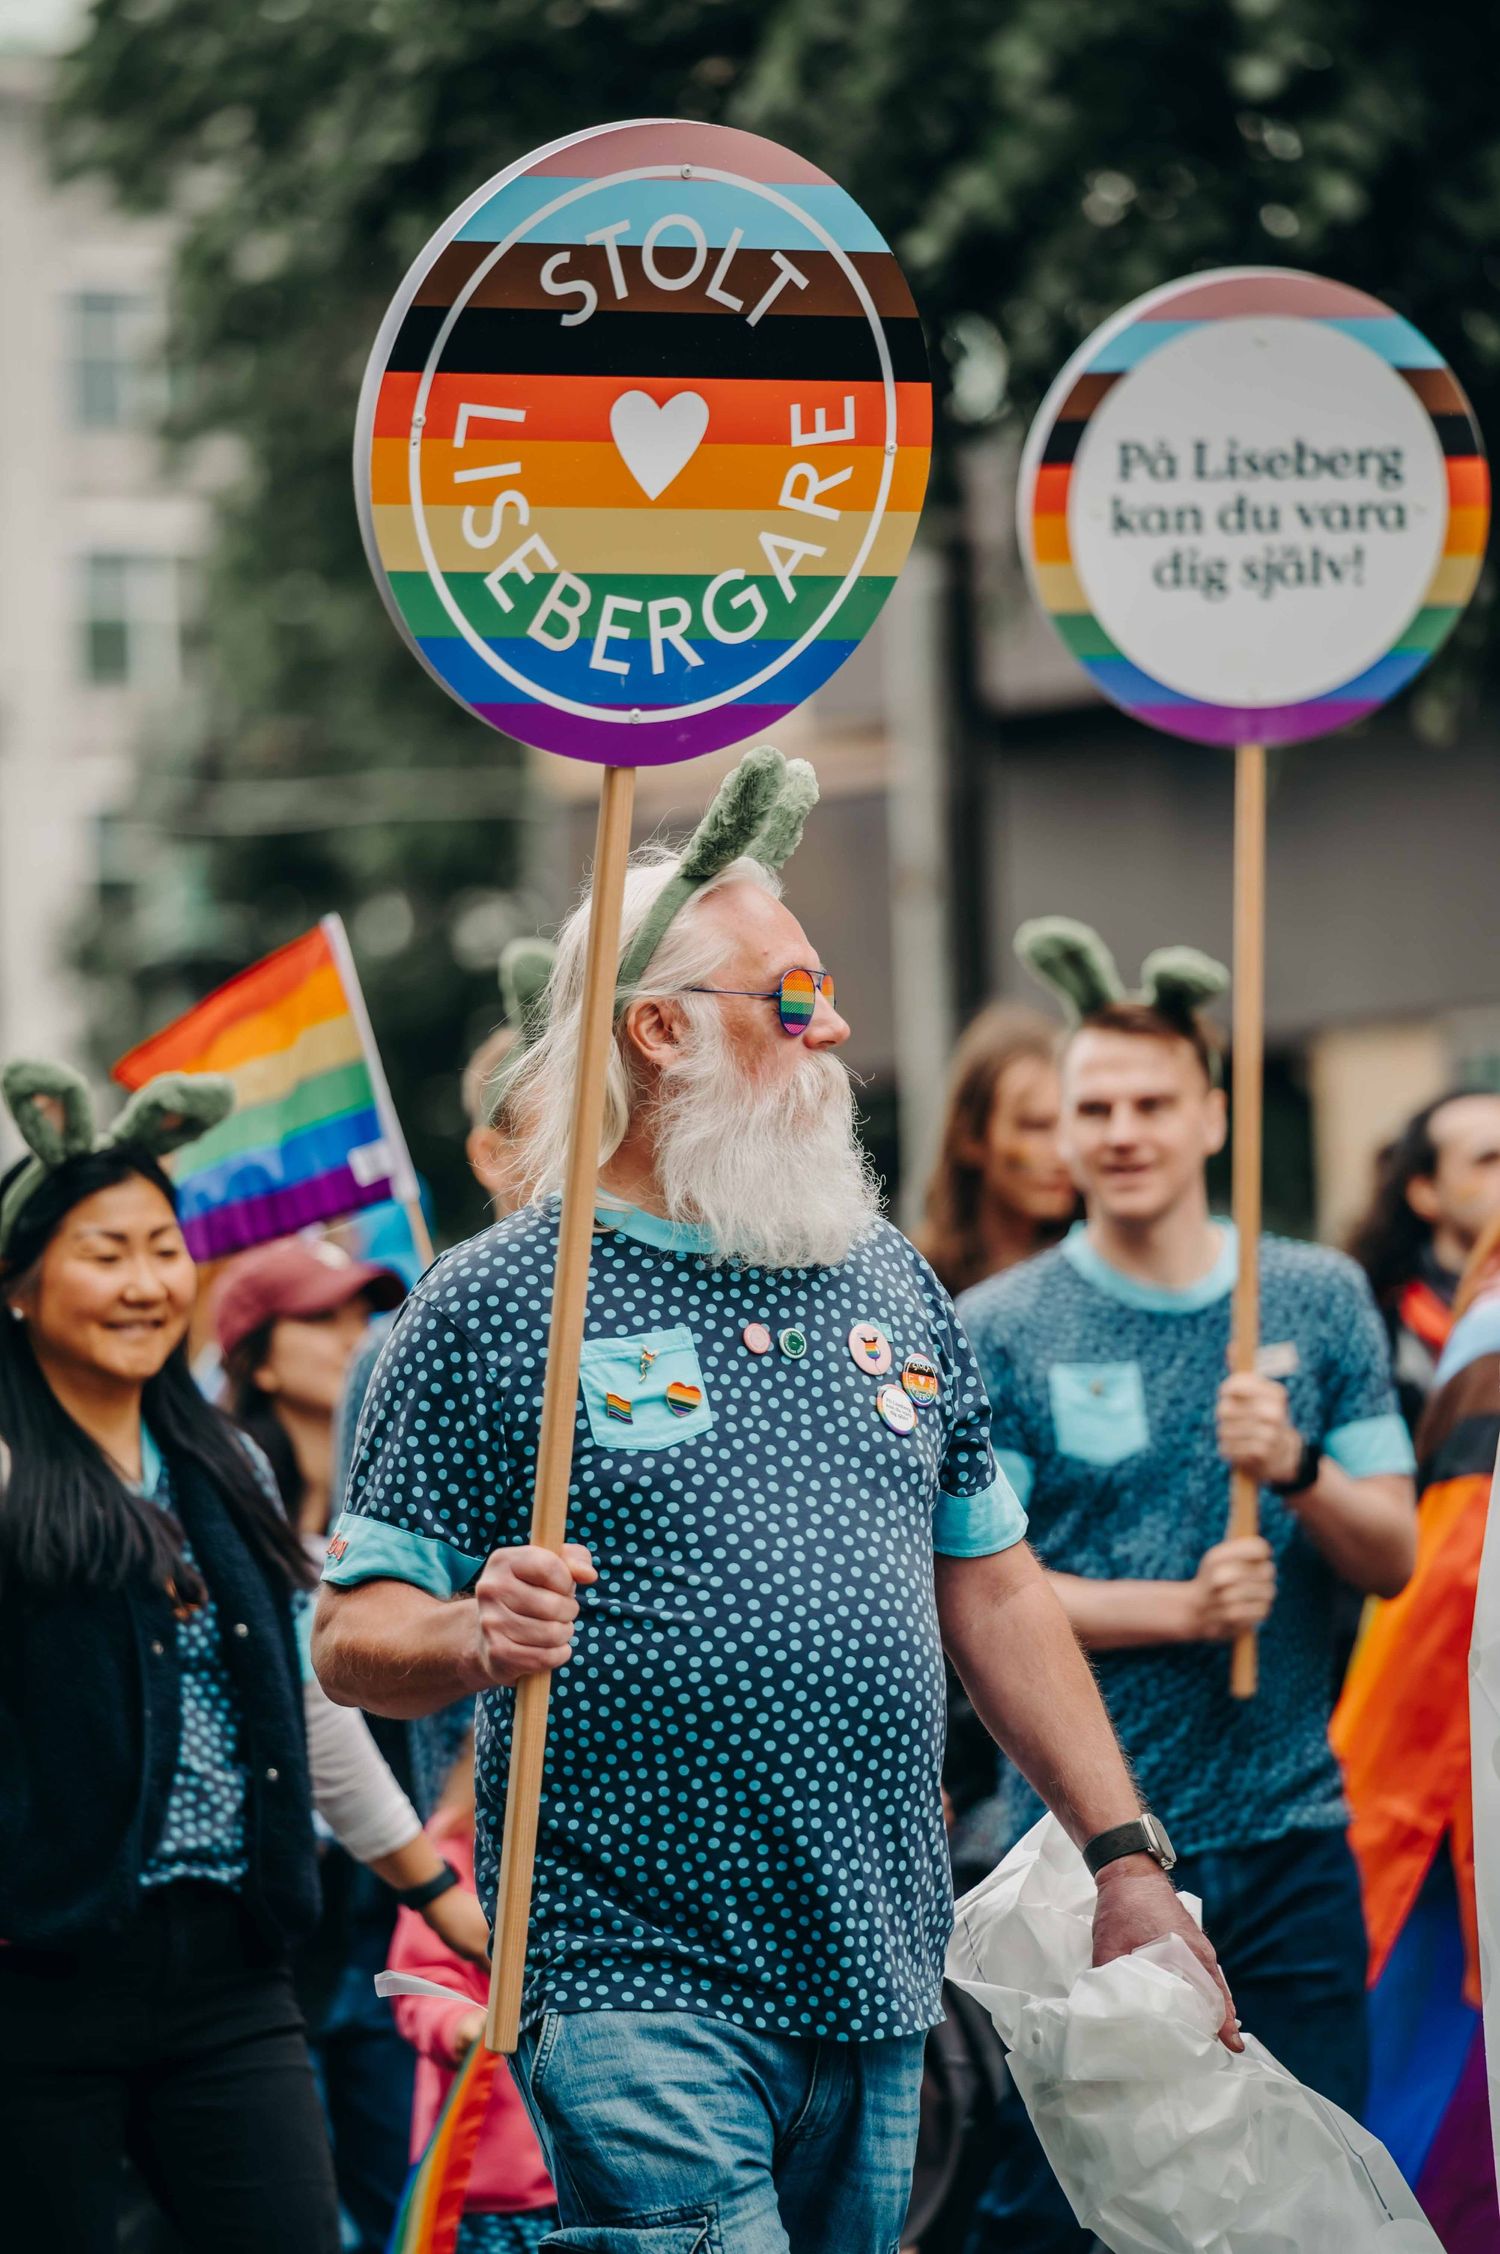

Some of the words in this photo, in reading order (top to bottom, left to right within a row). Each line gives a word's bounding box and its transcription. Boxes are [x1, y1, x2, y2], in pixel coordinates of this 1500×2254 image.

[540, 214, 809, 327] STOLT
[1118, 438, 1177, 482] På
[1195, 438, 1404, 490] Liseberg
[454, 396, 855, 676] LISEBERGARE
[1112, 496, 1202, 535] kan
[1218, 494, 1281, 533] du
[1297, 502, 1408, 533] vara
[1152, 548, 1228, 601] dig
[1242, 545, 1365, 600] själv!
